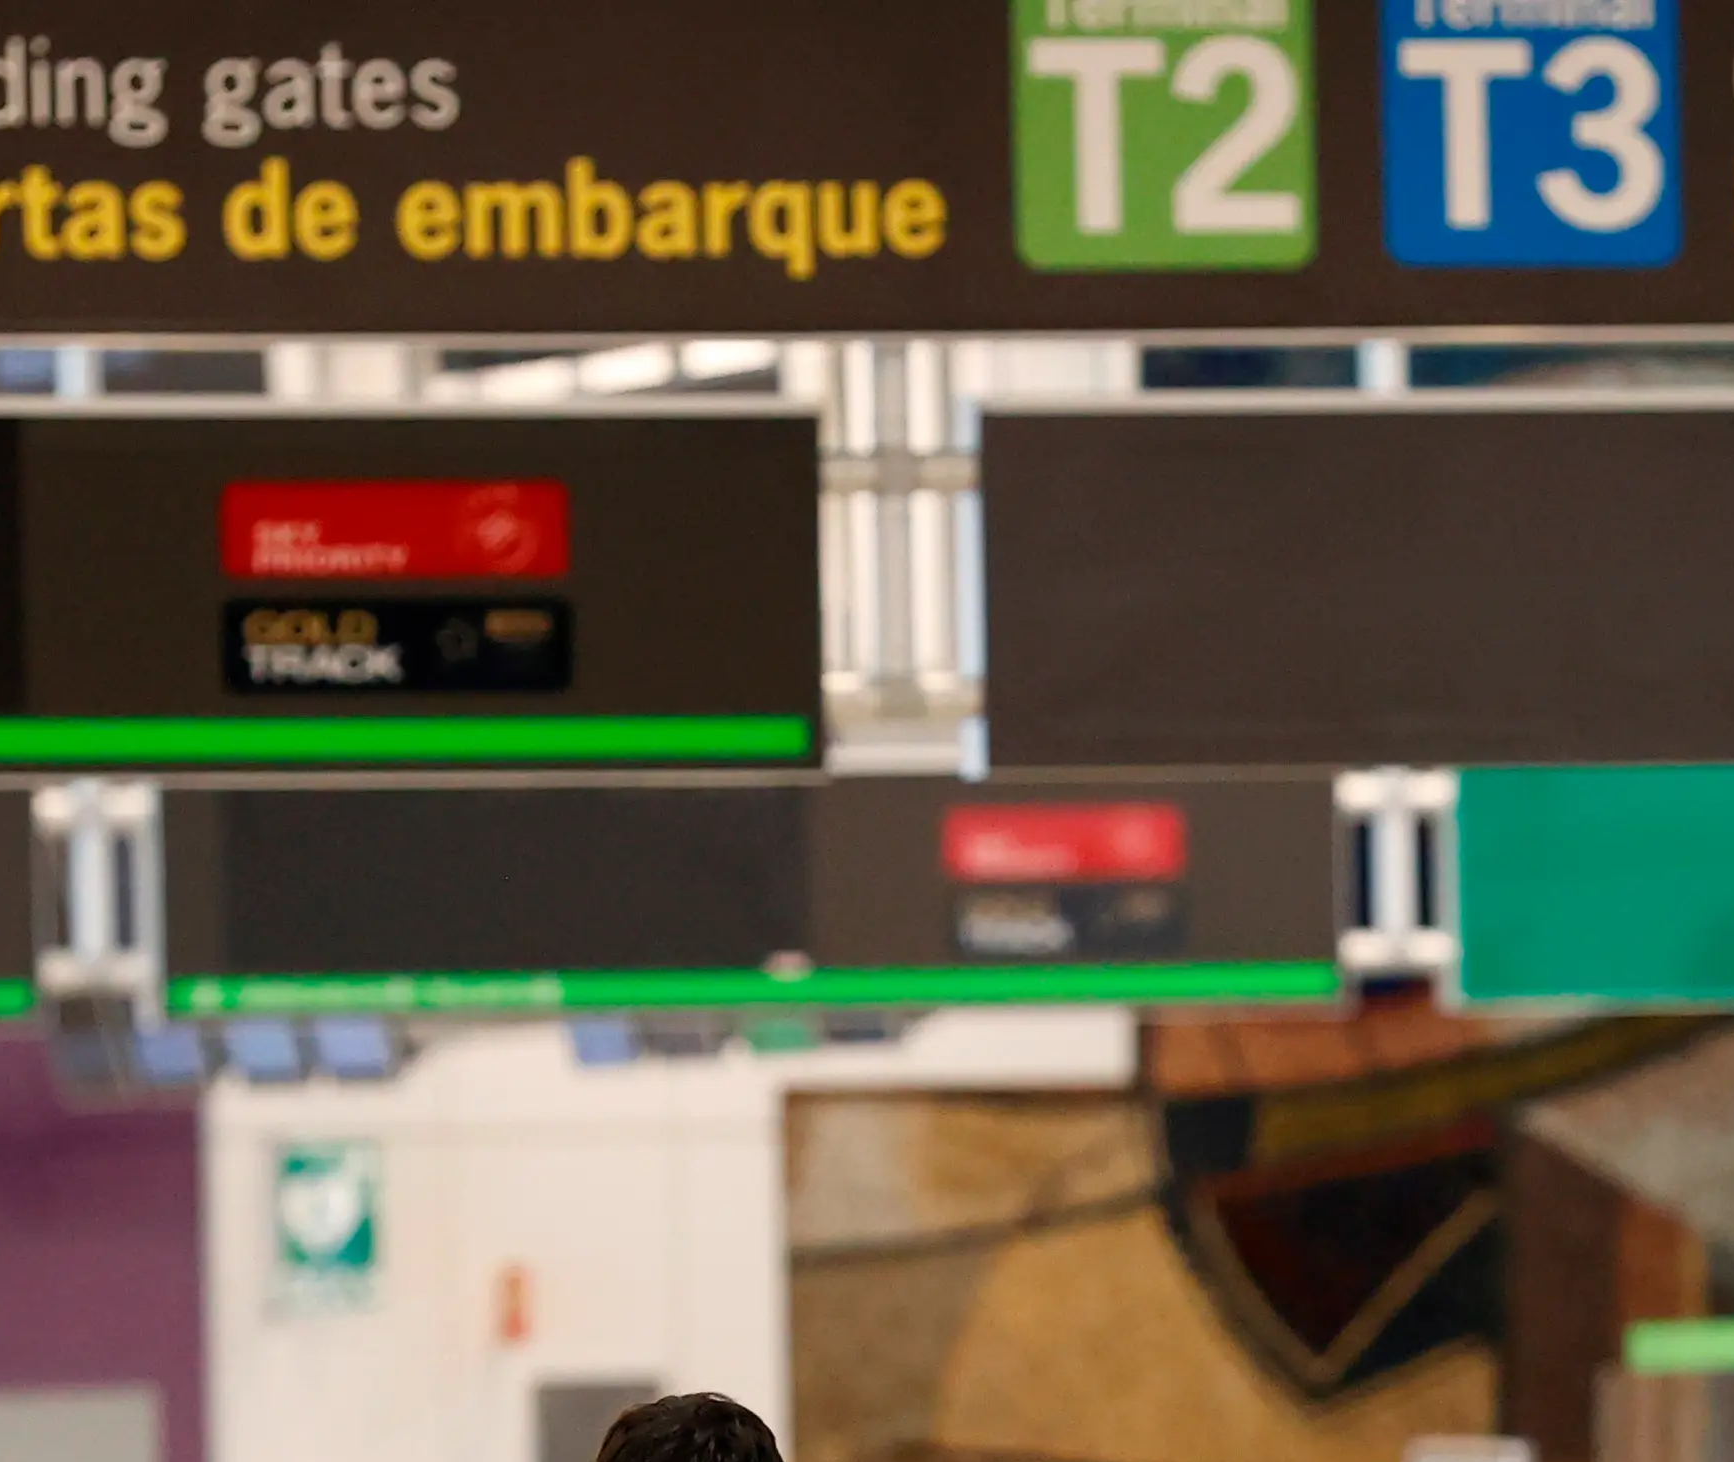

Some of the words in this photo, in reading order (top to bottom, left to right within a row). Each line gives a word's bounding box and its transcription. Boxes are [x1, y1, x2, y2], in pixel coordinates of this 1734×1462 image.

[201, 42, 460, 148] gates
[1026, 36, 1303, 235] T2
[1396, 36, 1665, 232] T3
[222, 155, 359, 260] de
[395, 155, 948, 280] embarque
[243, 609, 378, 646] GOLD
[243, 644, 403, 684] TRACK
